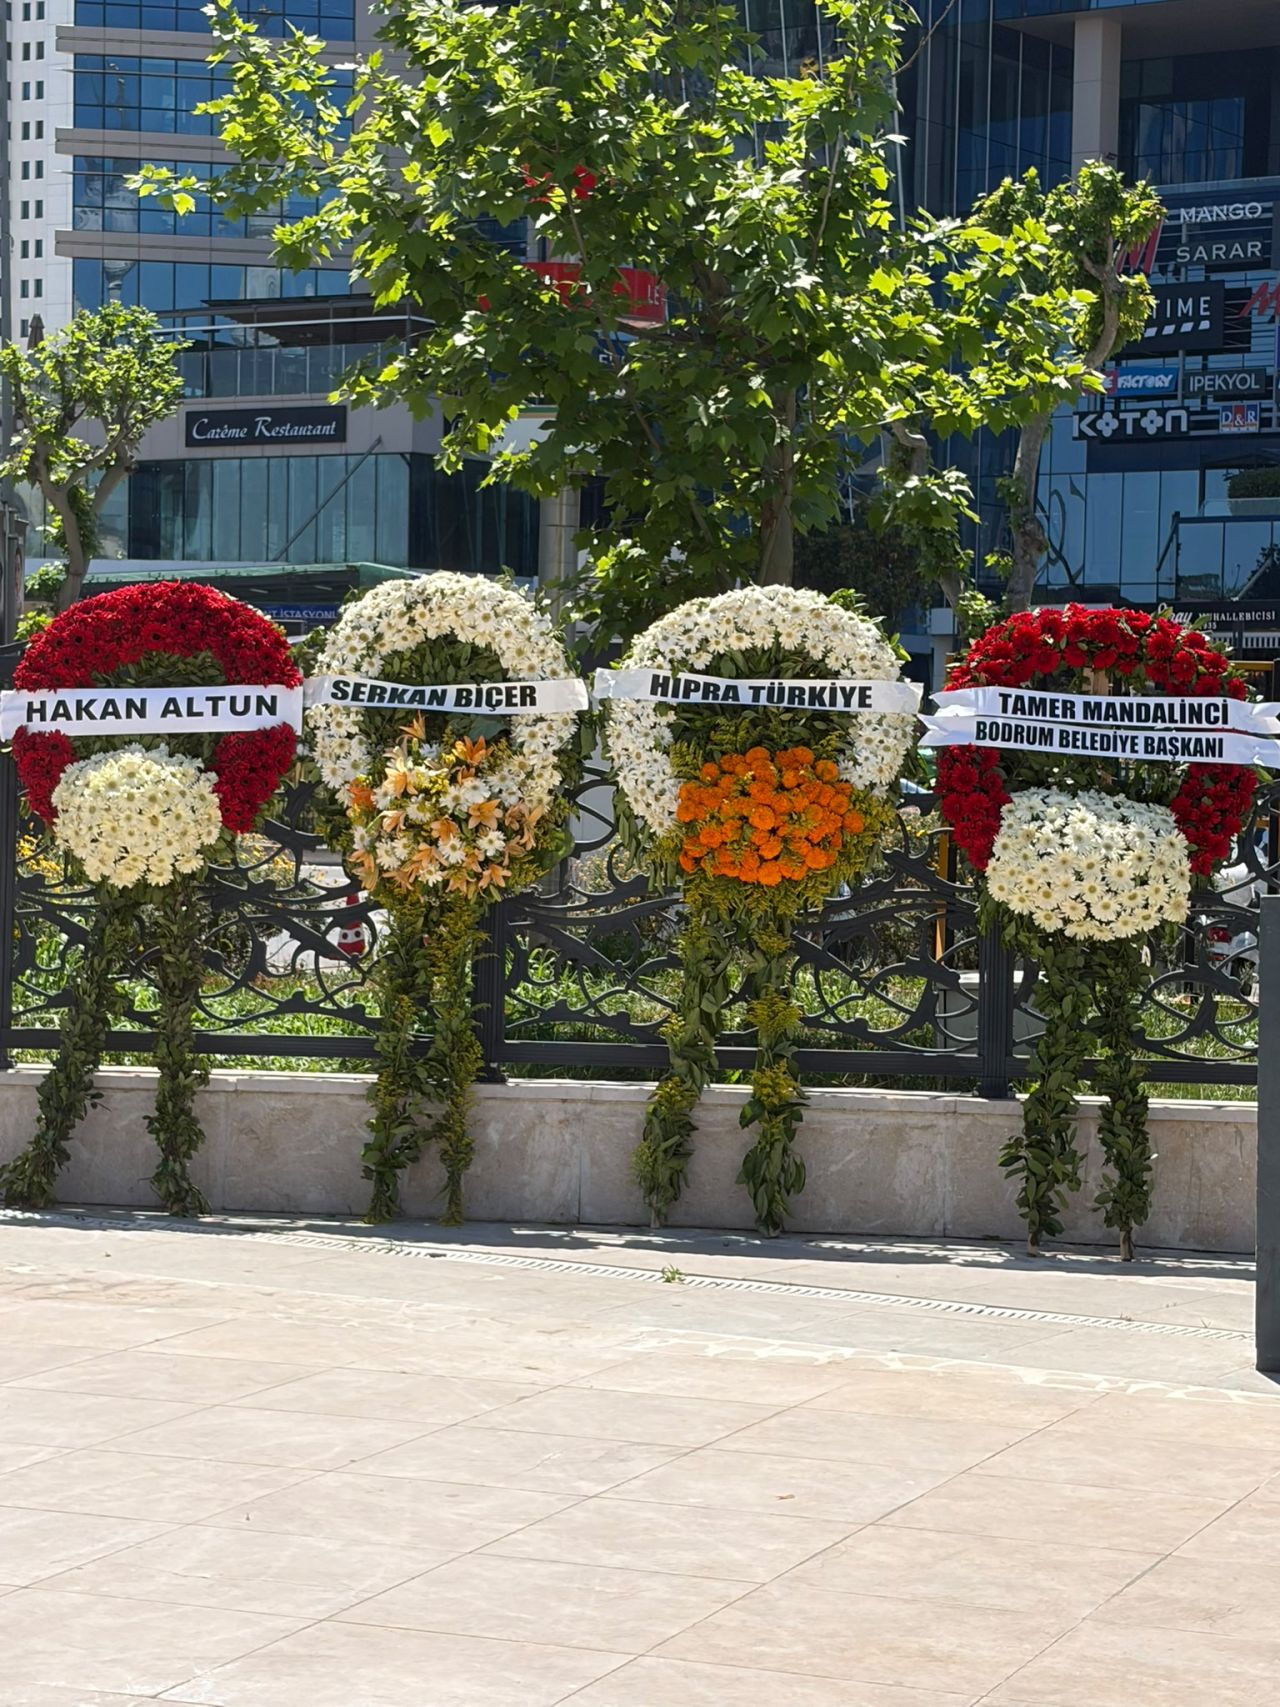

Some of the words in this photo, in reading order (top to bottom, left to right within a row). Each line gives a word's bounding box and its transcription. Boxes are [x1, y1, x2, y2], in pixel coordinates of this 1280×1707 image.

[1180, 202, 1262, 223] MANGO
[1176, 241, 1262, 263] SARAR
[1117, 374, 1174, 389] FACTORY
[1189, 373, 1260, 392] IPEKYOL
[192, 418, 248, 440] Carême
[254, 416, 336, 438] Restaurant
[1222, 411, 1257, 426] D&R
[331, 679, 448, 706] SERKAN
[454, 682, 537, 711] BİÇER
[748, 682, 873, 708] TÜRKİYE
[25, 697, 148, 723] HAKAN
[160, 694, 278, 718] ALTUN
[999, 692, 1076, 719] TAMER
[1082, 698, 1229, 725] MANDALİNCİ
[975, 721, 1054, 747] BODRUM
[1058, 730, 1140, 755] BELEDİYE
[1143, 734, 1224, 760] BAŞKANI
